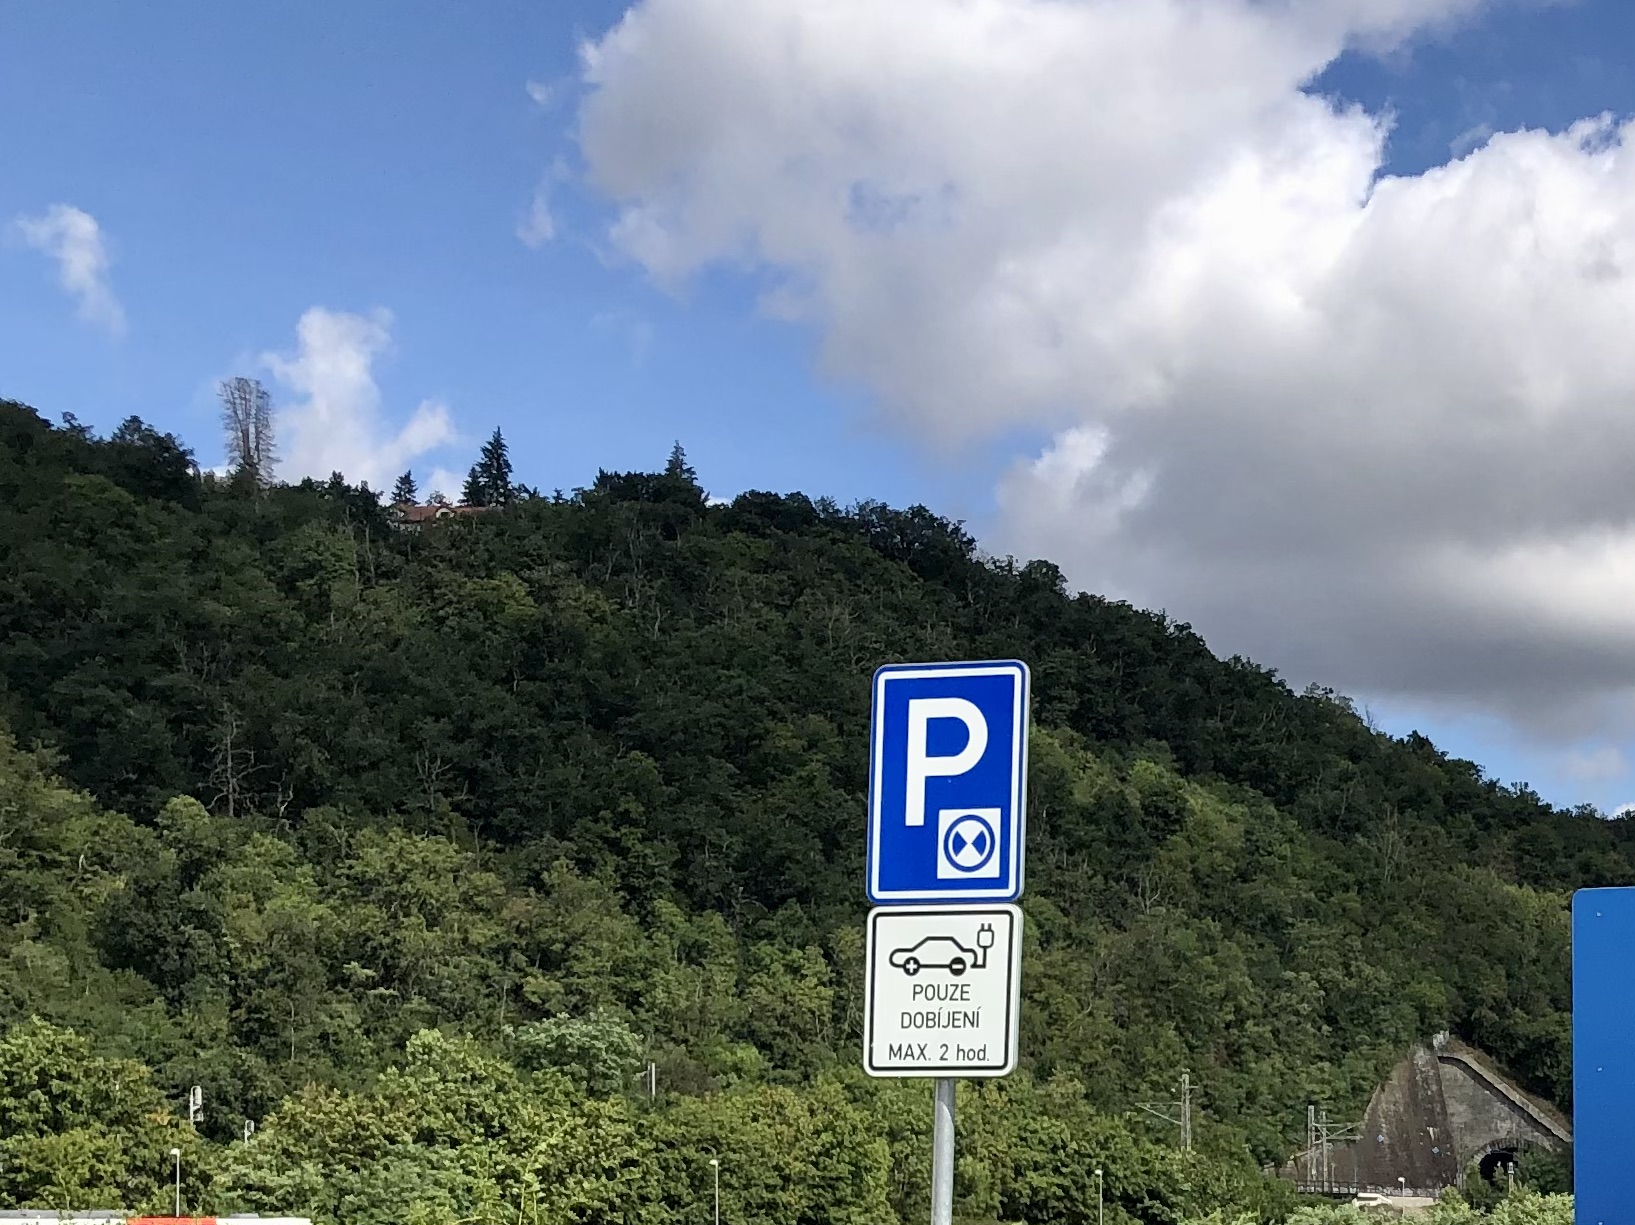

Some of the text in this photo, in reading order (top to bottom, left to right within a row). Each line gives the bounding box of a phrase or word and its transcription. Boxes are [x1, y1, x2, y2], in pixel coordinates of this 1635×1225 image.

[904, 697, 989, 826] P
[912, 983, 971, 1002] POUZE
[900, 1005, 982, 1029] DOBÍJENÍ
[888, 1043, 990, 1062] MAX. 2 hod.
